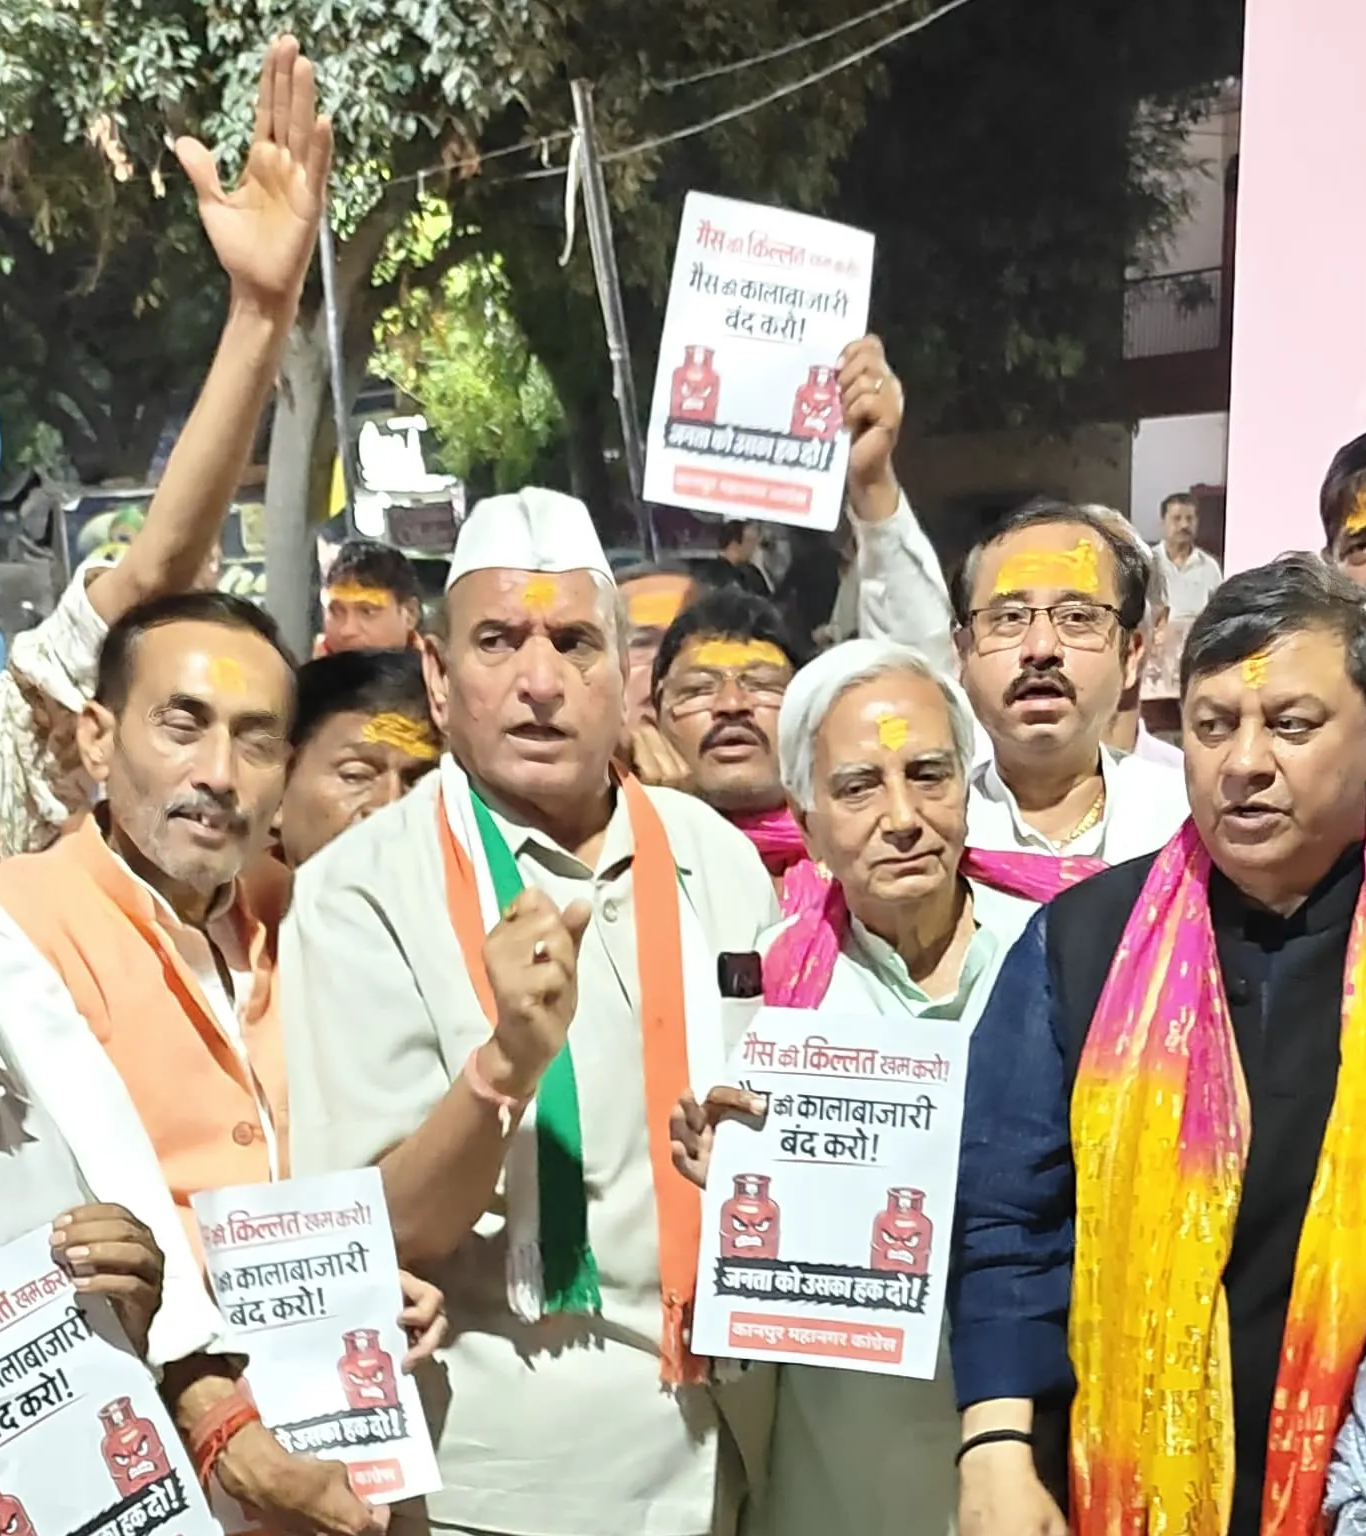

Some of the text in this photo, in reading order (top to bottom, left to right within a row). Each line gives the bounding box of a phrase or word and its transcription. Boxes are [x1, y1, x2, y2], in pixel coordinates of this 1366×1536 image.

[743, 1031, 776, 1067] गैस
[778, 1044, 799, 1068] की
[803, 1035, 879, 1075] किल्लत
[773, 1095, 795, 1118] की
[797, 1094, 938, 1131] कालाबाजारी
[780, 1124, 879, 1162] बंद करो!
[228, 1209, 302, 1244] किल्लत
[233, 1241, 370, 1290] कालाबाजारी
[226, 1285, 326, 1326] बंद करो!
[723, 1265, 922, 1307] जनता को उसका हक दो!
[731, 1322, 784, 1344] कानपुर
[788, 1327, 847, 1346] महानगर
[15, 1368, 74, 1418] करो!
[143, 1478, 180, 1518] दो!
